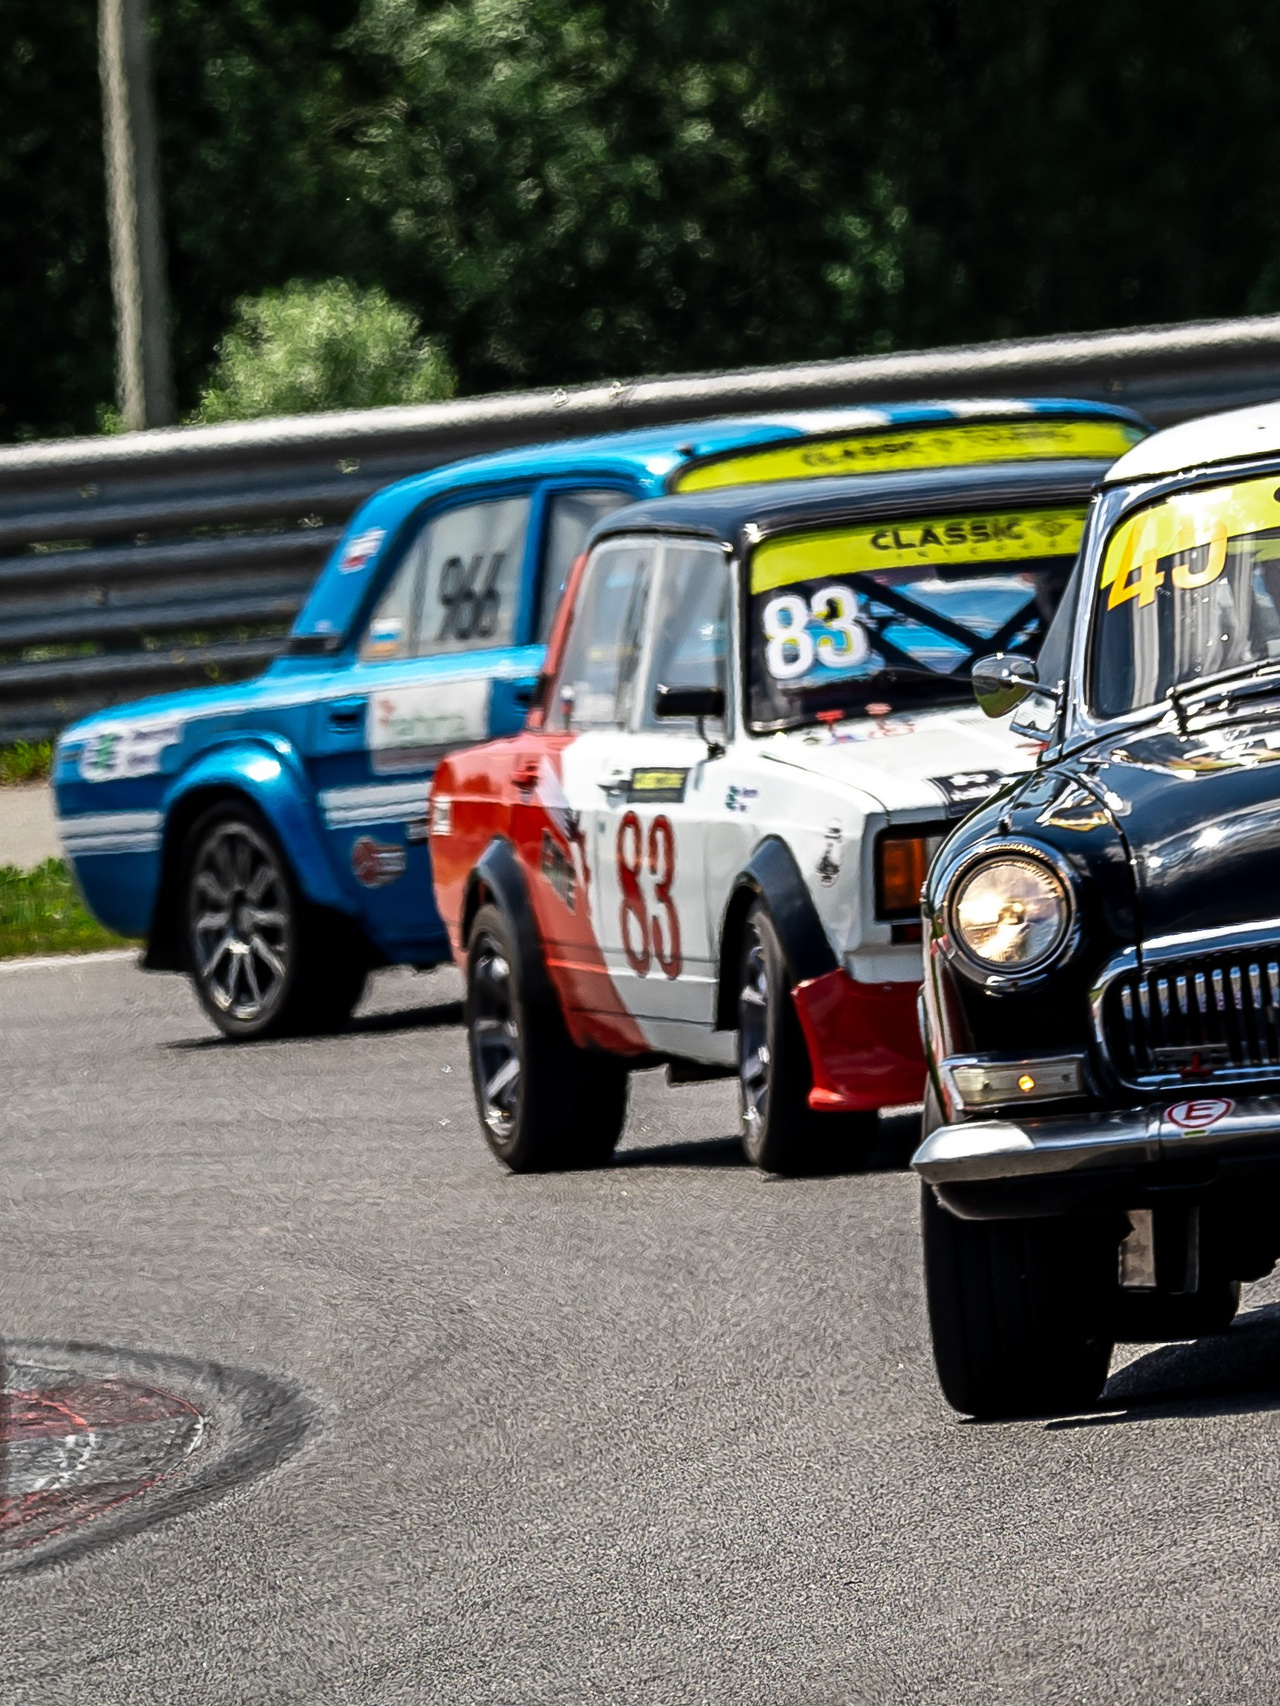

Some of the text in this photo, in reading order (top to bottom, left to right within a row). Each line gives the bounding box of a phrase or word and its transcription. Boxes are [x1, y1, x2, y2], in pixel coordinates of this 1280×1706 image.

[870, 516, 1025, 551] CLASSIC
[763, 585, 869, 680] 83
[615, 809, 682, 981] 83
